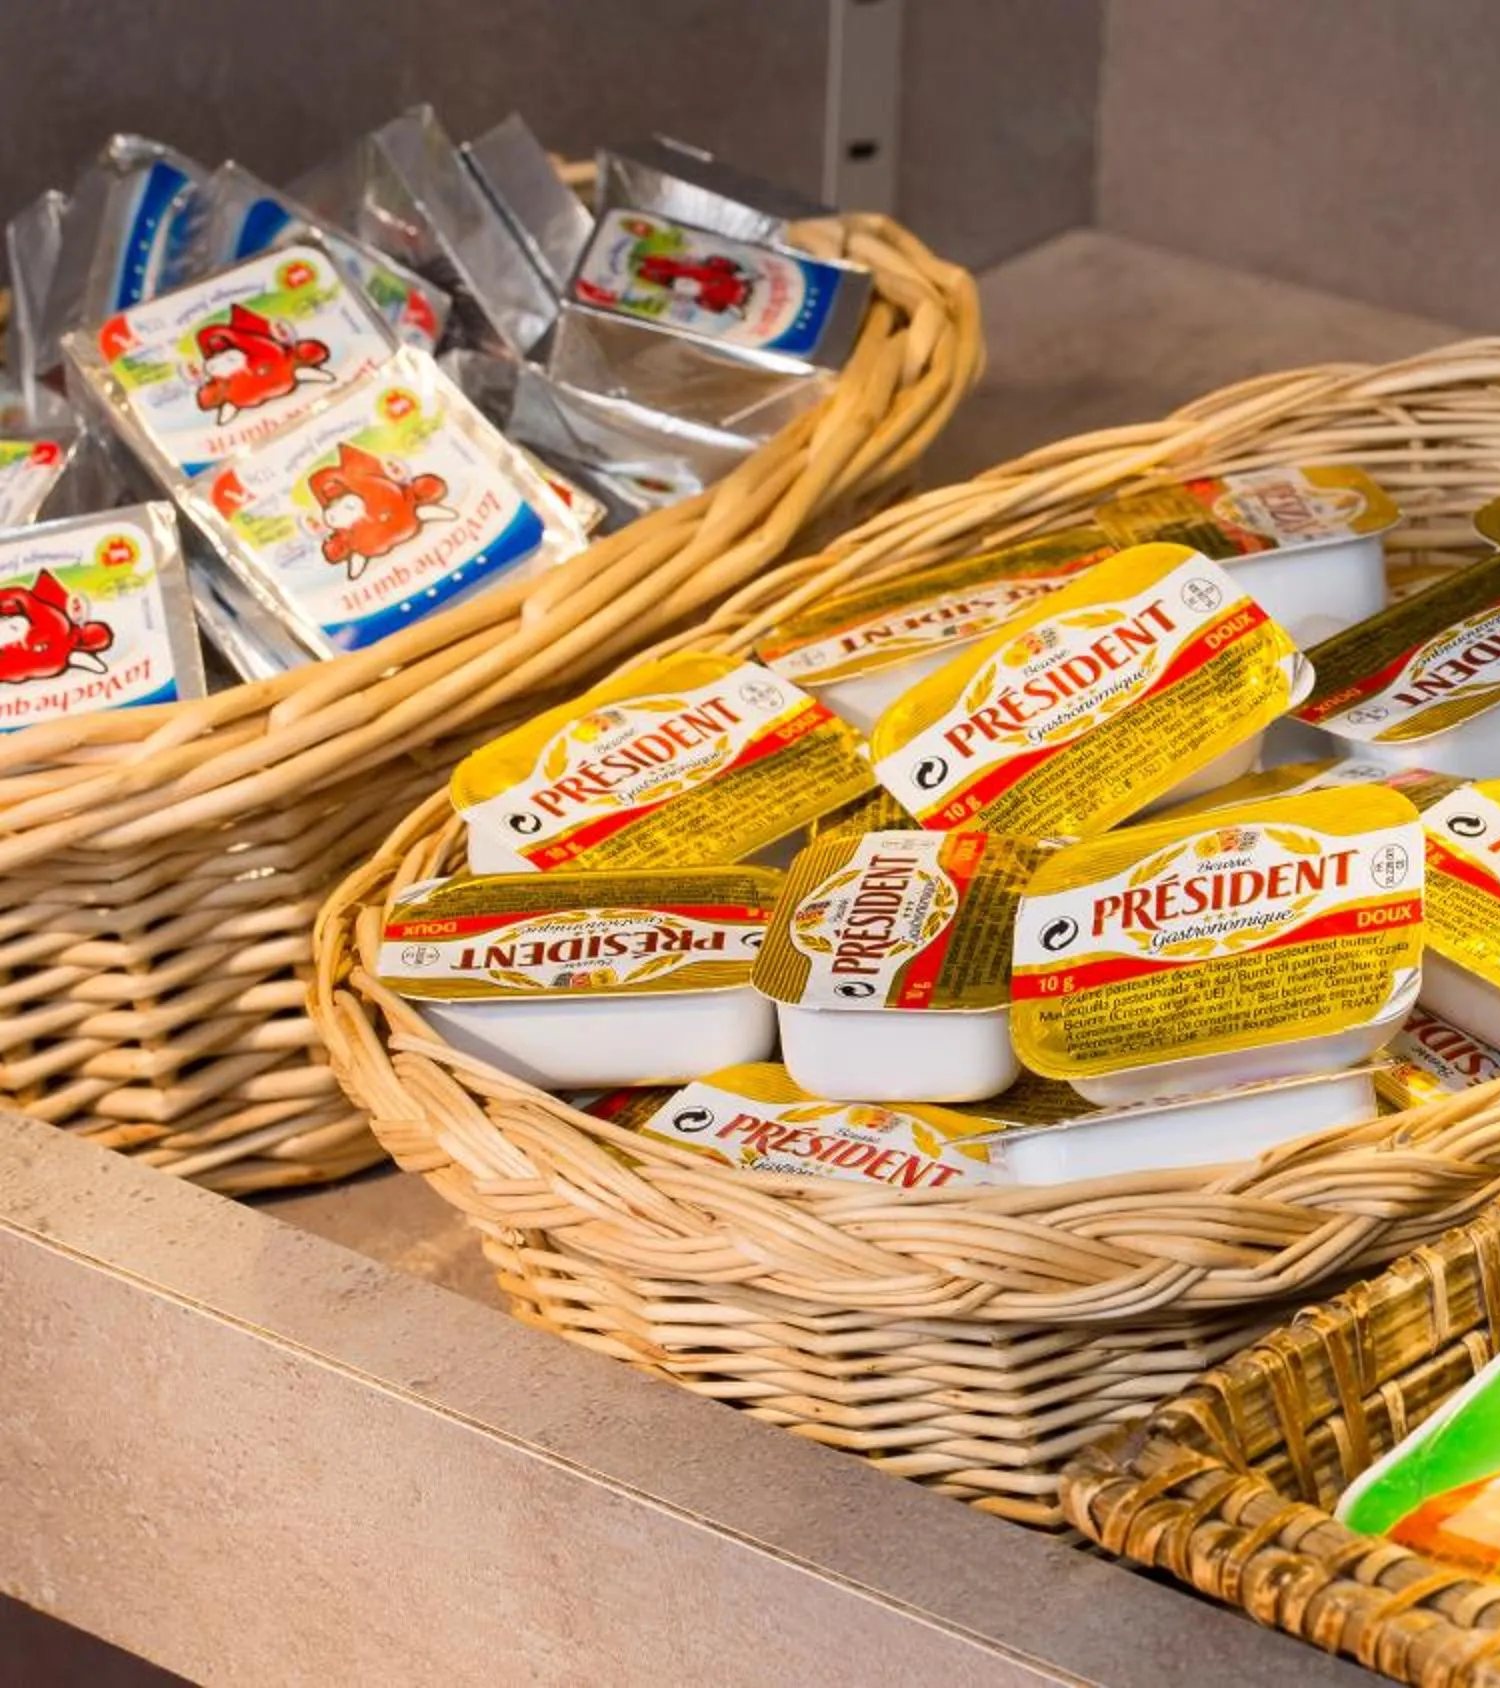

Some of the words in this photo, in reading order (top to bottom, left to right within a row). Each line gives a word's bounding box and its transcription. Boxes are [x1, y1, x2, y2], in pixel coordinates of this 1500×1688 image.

[412, 519, 485, 577] Vache
[372, 564, 412, 598] qui
[341, 588, 377, 616] rit
[1204, 612, 1256, 650] DOUX
[124, 659, 151, 683] la
[943, 598, 1180, 759] PRÉSIDENT
[32, 675, 123, 714] Vache
[1027, 666, 1154, 746] Gastronomique
[530, 697, 742, 818] PRÉSIDENT
[943, 799, 966, 822] 10
[966, 795, 983, 817] g
[1197, 855, 1254, 874] Beurre
[1091, 849, 1360, 937] PRÉSIDENT
[403, 920, 457, 936] DOUX
[831, 855, 920, 977] PRÉSIDENT
[1149, 906, 1297, 955] Gastronomique
[1357, 903, 1413, 929] DOUX
[449, 927, 725, 973] PRÉSIDENT
[1039, 976, 1059, 993] 10
[1061, 976, 1076, 995] g
[715, 1112, 963, 1188] PRÉSIDENT
